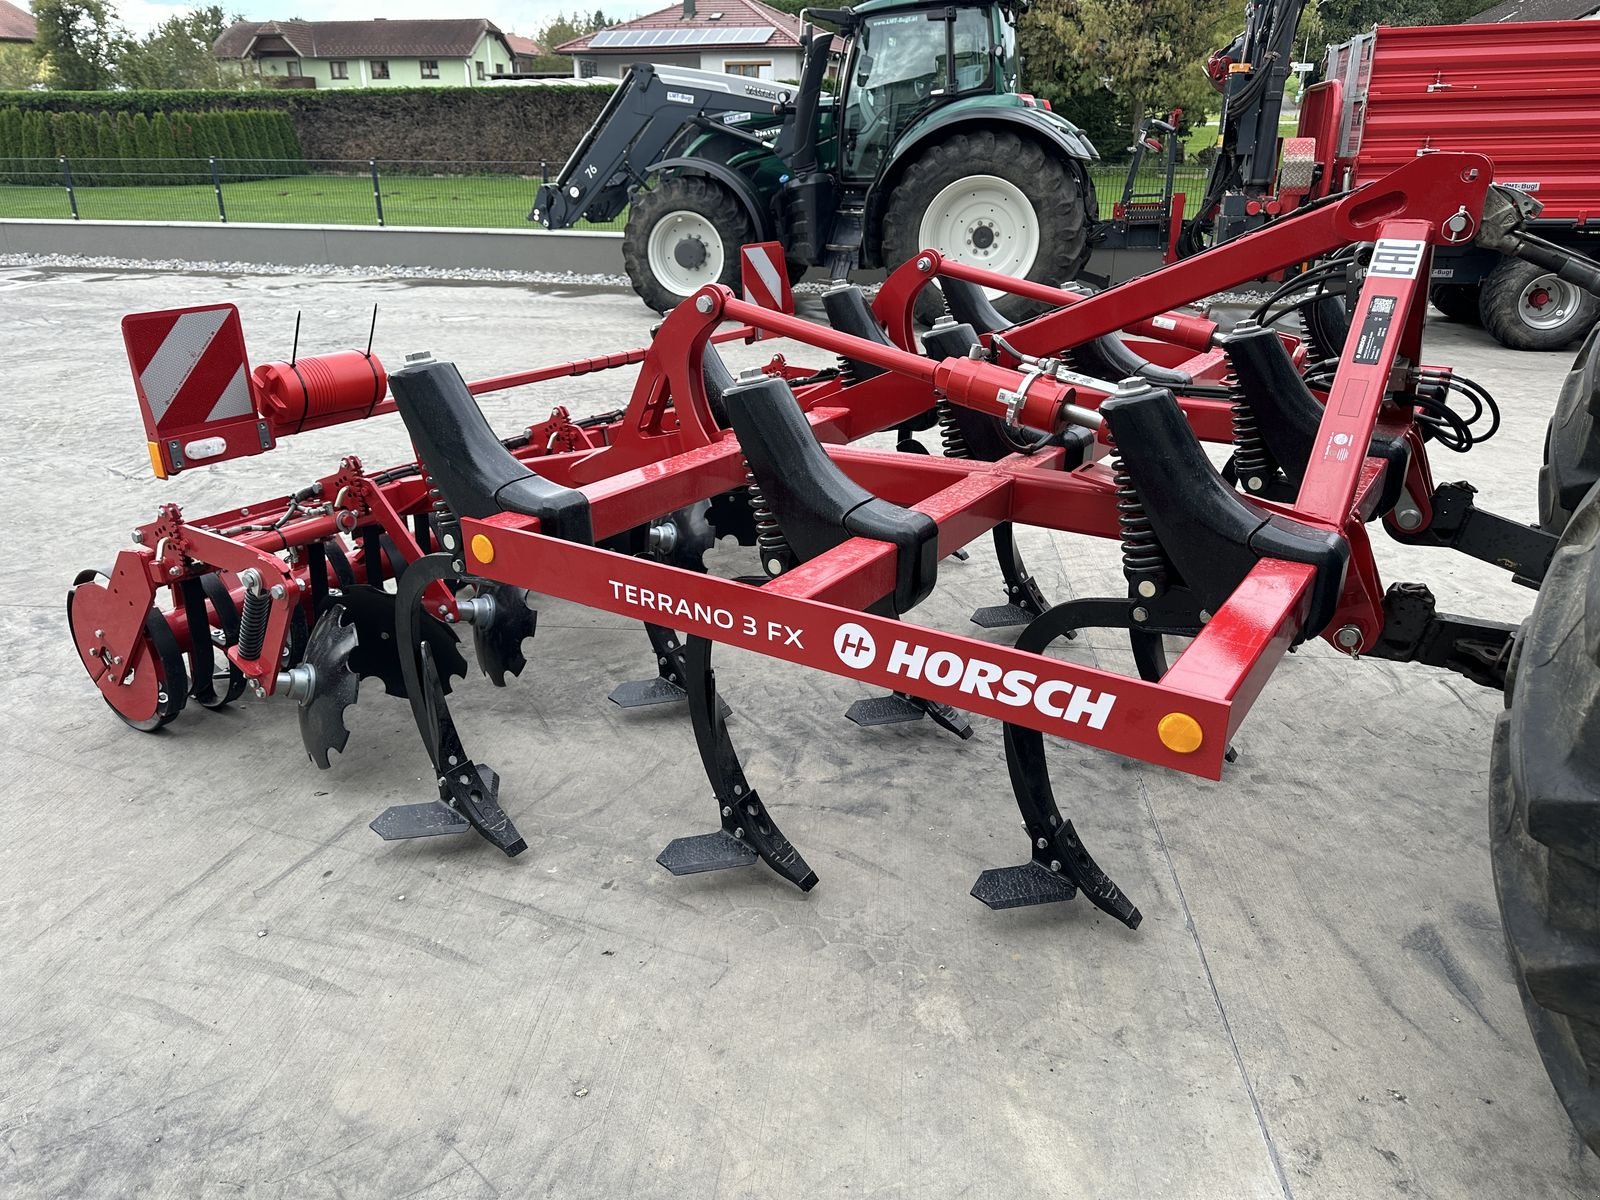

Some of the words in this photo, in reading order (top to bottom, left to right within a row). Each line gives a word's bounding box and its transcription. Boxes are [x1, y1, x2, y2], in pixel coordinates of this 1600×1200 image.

[744, 84, 777, 100] VALTRA
[584, 164, 598, 179] 76
[1371, 242, 1421, 275] EAC
[608, 579, 734, 629] TERRANO
[742, 615, 758, 636] 3
[767, 621, 805, 650] FX
[886, 639, 1117, 731] HORSCH
